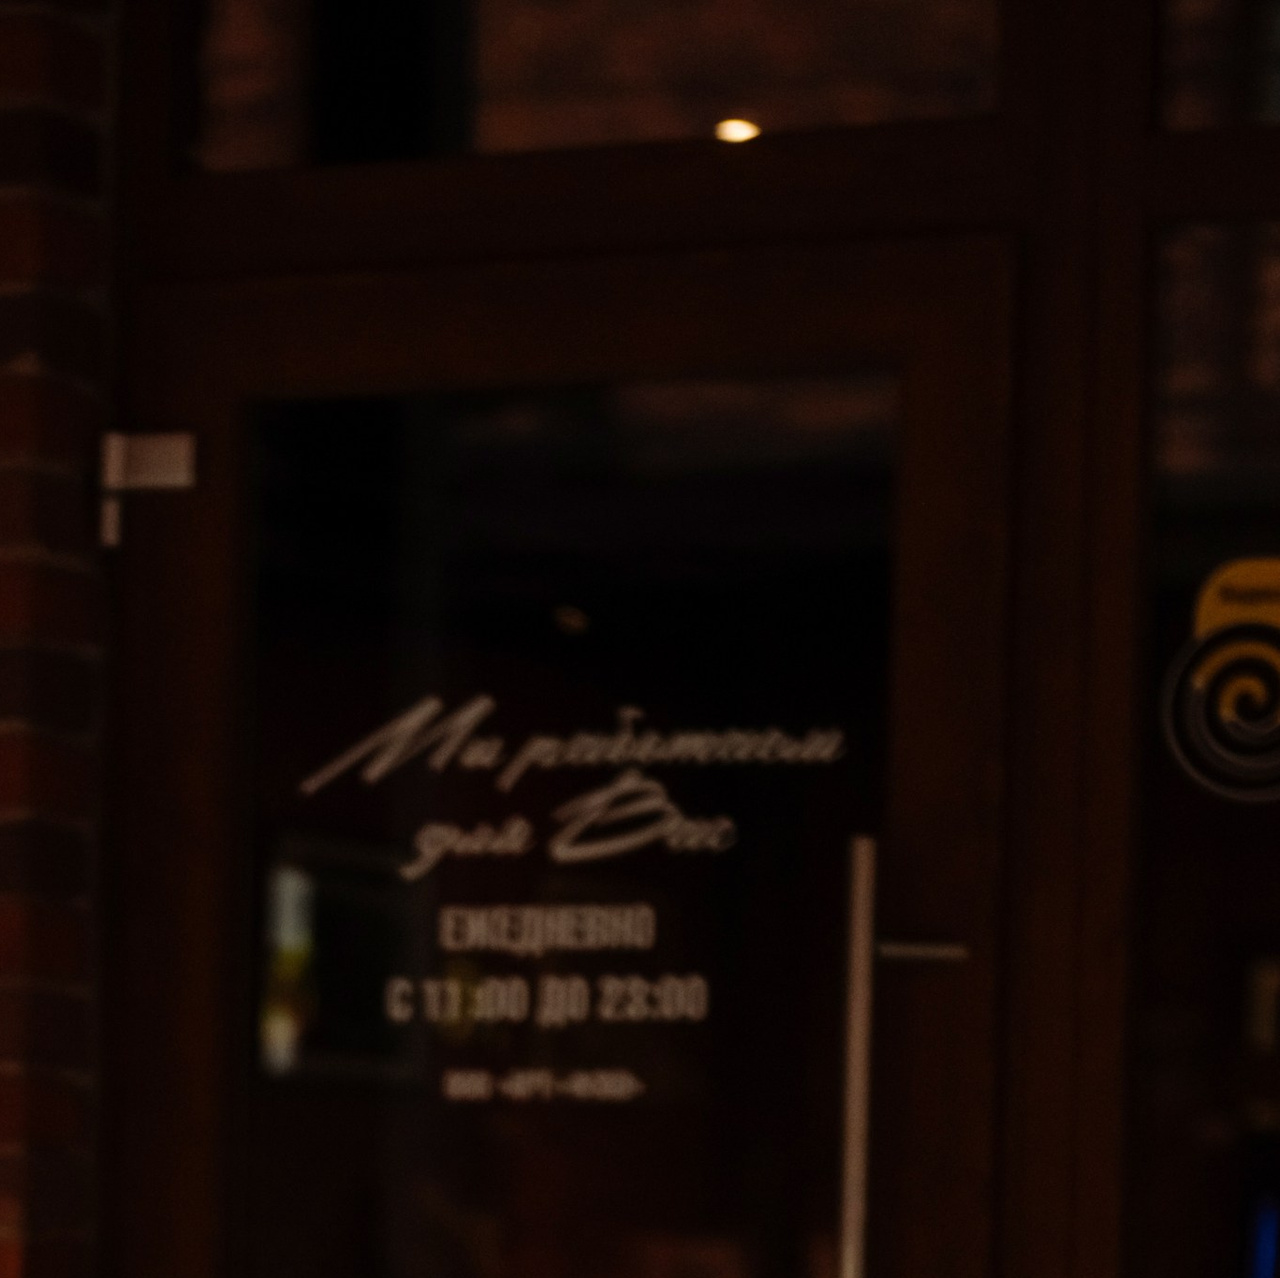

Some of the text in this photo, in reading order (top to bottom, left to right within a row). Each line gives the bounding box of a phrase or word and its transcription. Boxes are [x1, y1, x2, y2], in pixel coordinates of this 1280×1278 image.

[439, 905, 656, 957] ЕЖЕДНЕВНО
[385, 976, 413, 1022] С
[535, 975, 590, 1027] ДО
[598, 974, 709, 1021] 23:00
